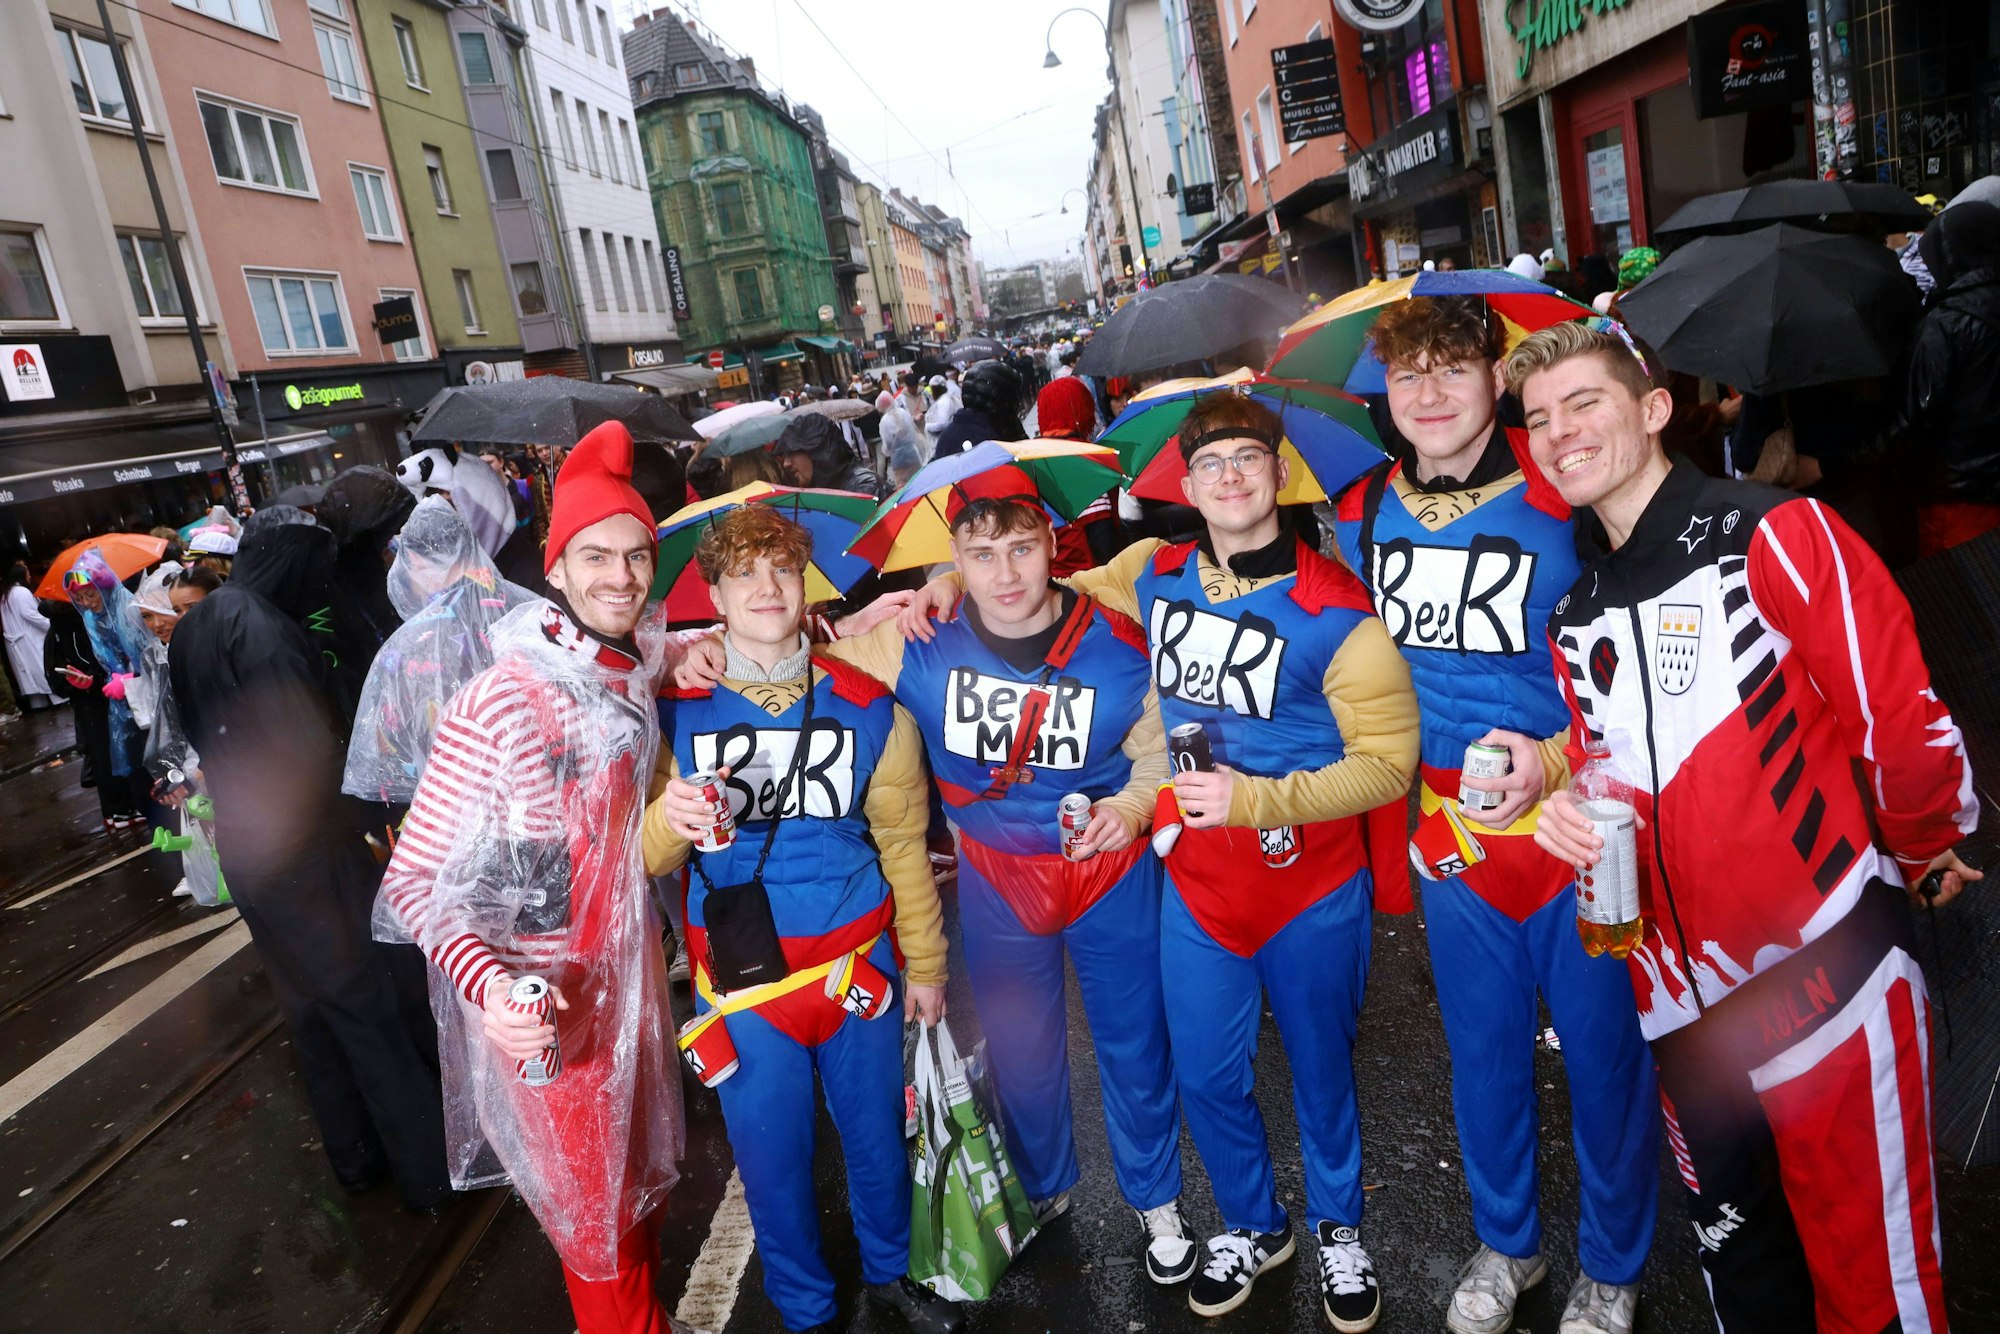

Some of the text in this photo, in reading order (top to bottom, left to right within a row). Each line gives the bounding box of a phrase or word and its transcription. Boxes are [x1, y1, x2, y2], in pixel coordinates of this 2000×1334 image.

[1274, 49, 1288, 63] M
[1278, 69, 1288, 82] T
[1721, 68, 1787, 92] Fant-asia
[1281, 89, 1292, 102] C
[1283, 102, 1338, 120] MUSIC CLUB
[1385, 130, 1437, 177] KWARTIER
[378, 314, 412, 329] duma
[302, 382, 365, 407] asiagourmet
[52, 477, 85, 493] Steaks
[113, 466, 152, 483] Schnitzel
[174, 459, 202, 473] Burger
[243, 449, 266, 462] Coffee
